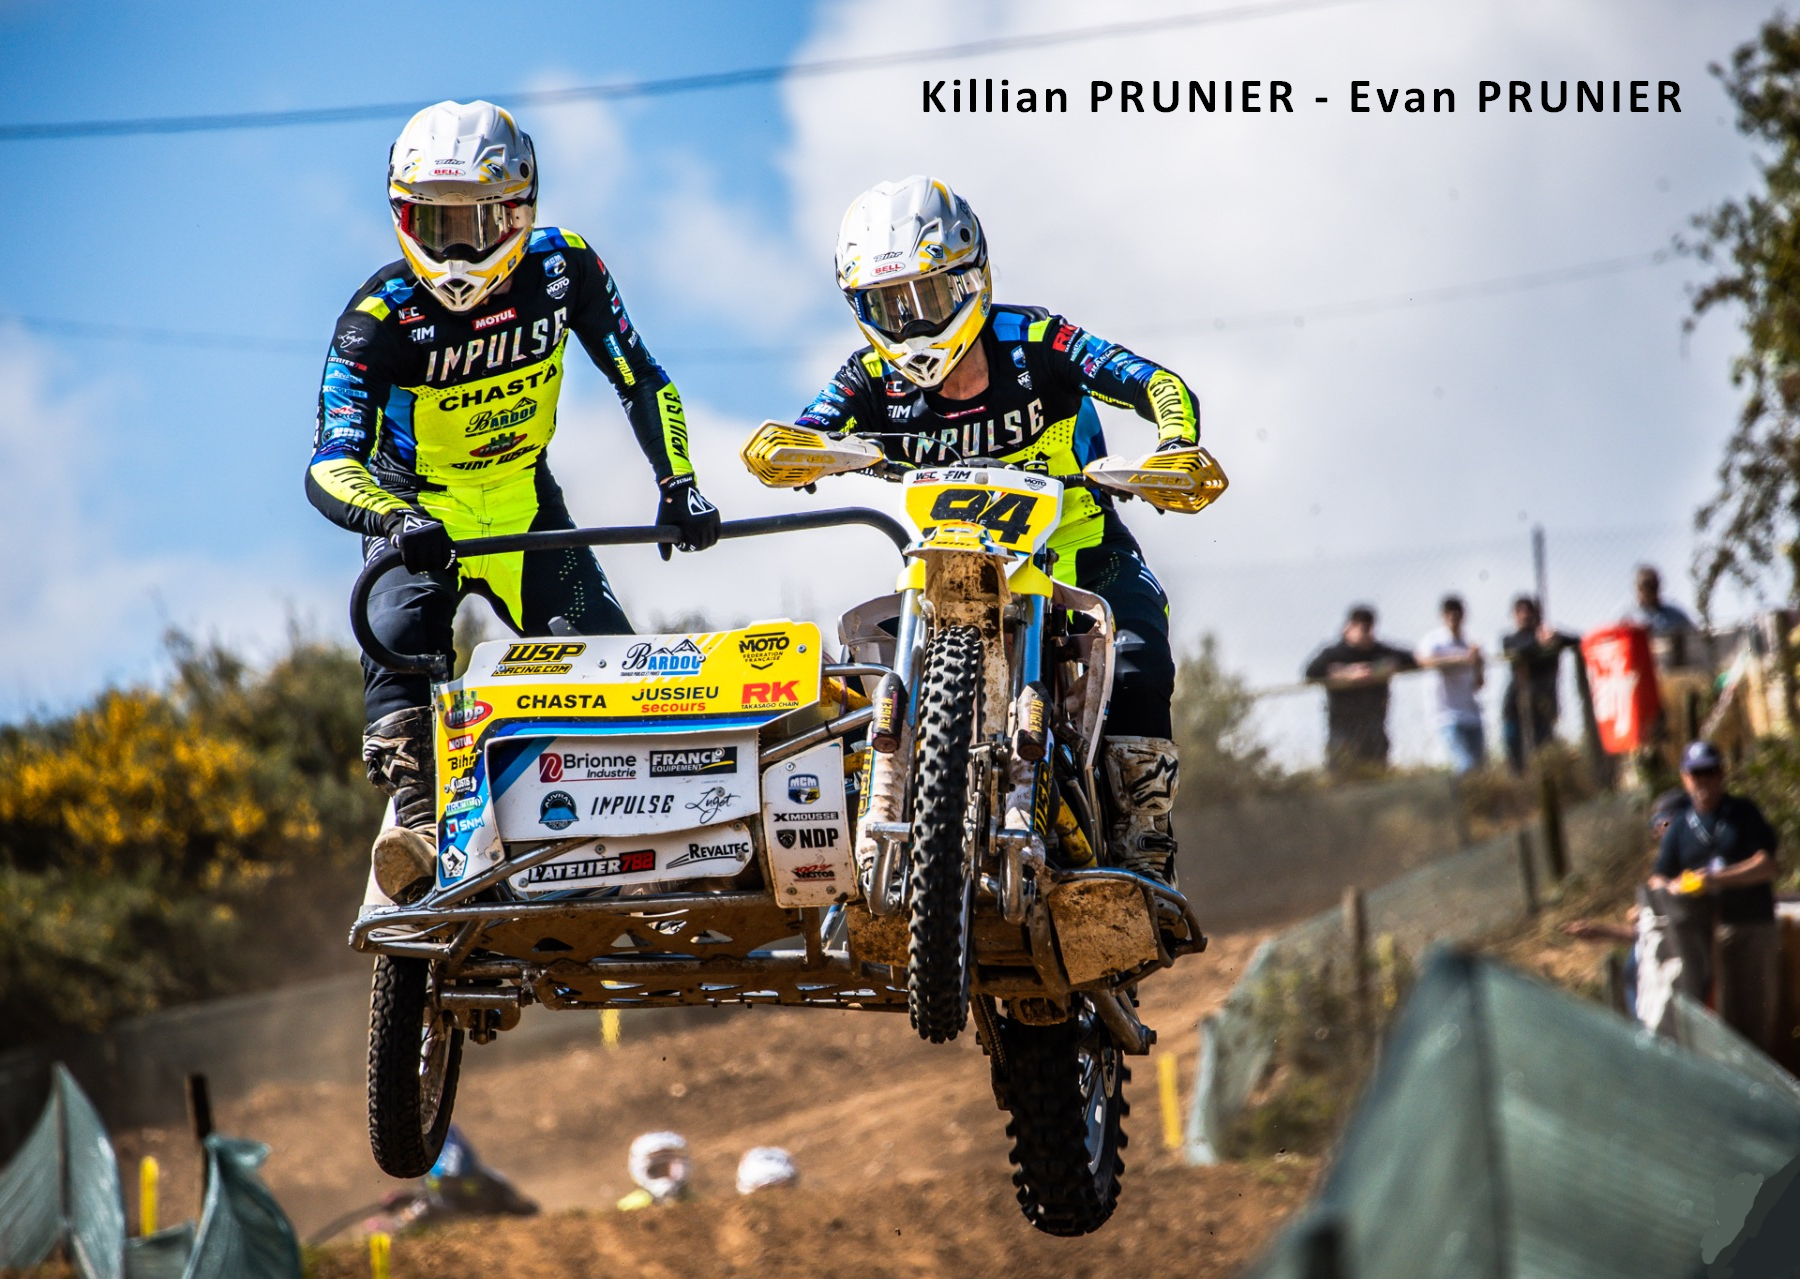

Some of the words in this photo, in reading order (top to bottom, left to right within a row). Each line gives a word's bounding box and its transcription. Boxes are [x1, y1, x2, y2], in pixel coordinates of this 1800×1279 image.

[875, 264, 902, 274] BELL
[546, 278, 570, 295] MOTO
[475, 309, 515, 329] MOTUL
[426, 306, 567, 382] IMPULSE
[439, 363, 557, 411] CHASTA
[465, 403, 537, 433] BARDOU
[902, 398, 1044, 462] IMPULSE
[943, 470, 972, 480] FIM
[1024, 478, 1047, 487] MOTO
[921, 489, 1039, 545] 94
[502, 644, 586, 662] WSP
[739, 636, 790, 653] MOTO
[622, 642, 701, 670] BARDOU
[741, 680, 800, 704] RK
[516, 694, 607, 709] CHASTA
[641, 702, 706, 713] secours
[449, 705, 485, 726] URDP
[877, 698, 893, 730] REIGER
[1028, 699, 1044, 733] REIGER
[448, 735, 473, 750] MOTUL
[448, 754, 475, 771] Bihr
[563, 754, 637, 769] Brionne
[652, 763, 703, 772] EQUIPEMENT
[587, 769, 637, 778] Industrie
[544, 793, 573, 808] AUVRAY
[590, 795, 675, 815] IMPULSE
[459, 818, 484, 831] SNM
[799, 828, 839, 848] NDP
